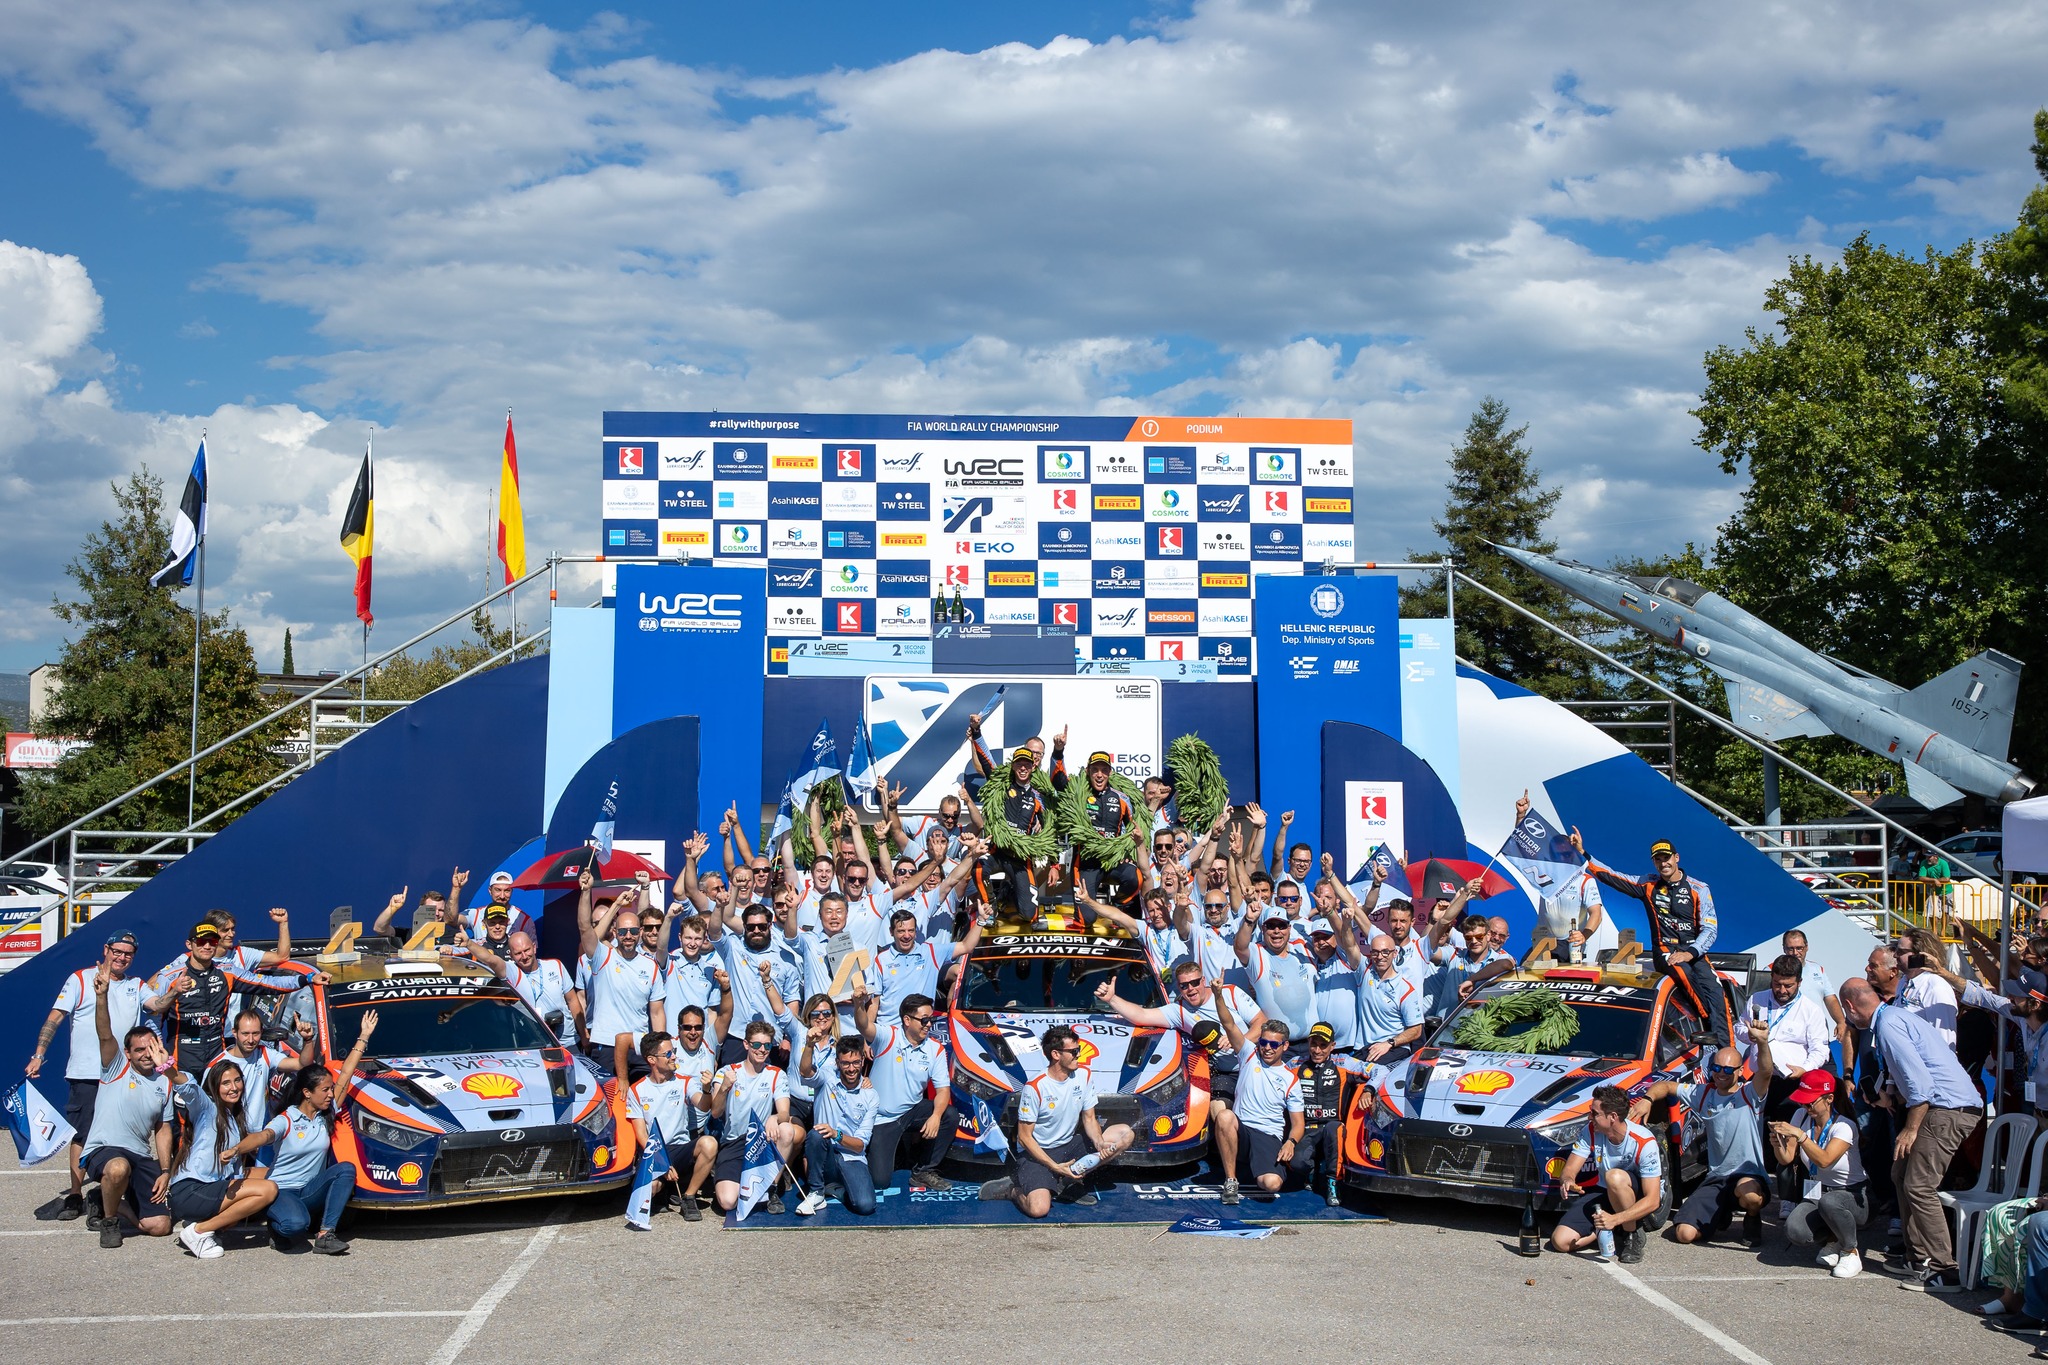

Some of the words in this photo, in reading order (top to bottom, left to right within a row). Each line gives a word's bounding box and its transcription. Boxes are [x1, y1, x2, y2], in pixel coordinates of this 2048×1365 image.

[709, 419, 799, 431] #rallywithpurpose
[907, 421, 923, 431] FIA
[925, 422, 959, 432] WORLD
[960, 422, 988, 432] RALLY
[990, 422, 1060, 433] CHAMPIONSHIP
[1186, 424, 1223, 434] PODIUM
[776, 458, 814, 467] PIRELLI
[944, 458, 1024, 476] WRC
[1096, 465, 1111, 473] TW
[945, 480, 959, 488] FIA
[663, 500, 679, 508] TW
[679, 500, 708, 508] STEEL
[771, 497, 819, 505] AsahiKASEI
[1099, 498, 1136, 508] PIRELLI
[1310, 501, 1347, 510] PIRELLI
[881, 502, 896, 510] TW
[897, 502, 926, 510] STEEL
[667, 533, 705, 543] PIRELLI
[885, 535, 923, 545] PIRELLI
[1095, 537, 1141, 545] AsahiKASEI
[974, 542, 1015, 554] EKO
[1306, 539, 1352, 548] AsahiKASEI
[880, 574, 928, 583] AsahiKASEI
[993, 574, 1031, 583] PIRELLI
[1206, 576, 1243, 585] PIRELLI
[639, 592, 743, 616] WRC
[840, 605, 858, 625] K
[988, 613, 1036, 621] AsahiKASEI
[1202, 614, 1248, 623] AsahiKASEI
[640, 619, 658, 630] FIA
[773, 617, 788, 625] TW
[789, 617, 816, 625] STEEL
[959, 626, 992, 634] WRC
[1280, 624, 1326, 633] HELLENIC
[1329, 624, 1375, 634] REPUBLIC
[1282, 636, 1302, 645] Dep.
[1304, 636, 1336, 646] Ministry
[1338, 636, 1346, 644] of
[1348, 637, 1375, 646] Sports
[814, 643, 848, 651] WRC
[892, 644, 902, 656] 2
[1099, 662, 1130, 670] WRC
[1178, 663, 1187, 675] 3
[1115, 685, 1151, 694] WRC
[1951, 697, 1989, 721] 10577
[1117, 754, 1151, 763] EKO
[1514, 828, 1541, 853] YUNDAI
[1024, 935, 1087, 944] HYUNDAI
[5, 940, 37, 949] FERRIES
[1007, 946, 1107, 955] FANATEC
[382, 977, 452, 986] HYUNDAI
[1529, 983, 1597, 991] HYUNDAI
[369, 987, 475, 1000] FANATEC
[423, 1054, 495, 1065] HYUNDAI
[1471, 1053, 1539, 1061] HYUNDAI
[452, 1058, 541, 1071] MOBIS
[1481, 1057, 1569, 1074] MOBIS
[1306, 1108, 1337, 1118] MOBIS
[372, 1169, 398, 1181] WIA
